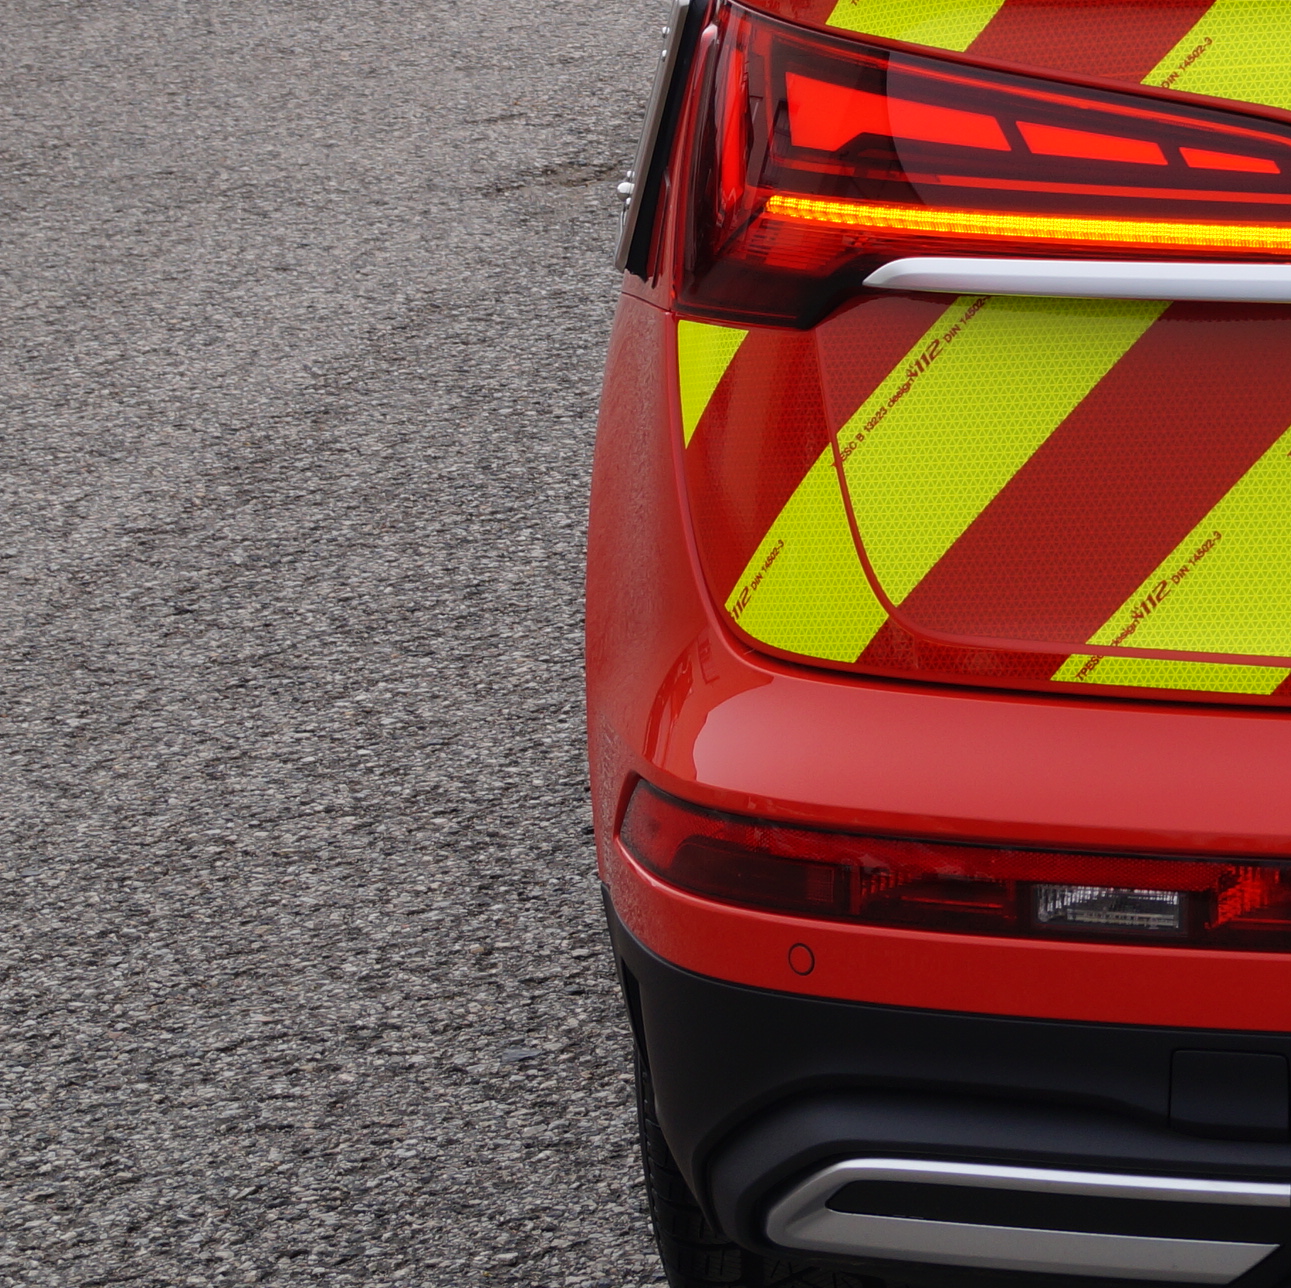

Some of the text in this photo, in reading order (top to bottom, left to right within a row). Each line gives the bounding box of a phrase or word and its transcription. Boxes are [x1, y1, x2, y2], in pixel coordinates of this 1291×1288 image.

[1178, 36, 1213, 72] 14502-3
[855, 432, 866, 442] B
[863, 406, 889, 433] 13223
[942, 323, 962, 344] DIN
[1170, 564, 1191, 585] DIN
[1187, 530, 1223, 566] 14502-3
[750, 571, 764, 591] DIN
